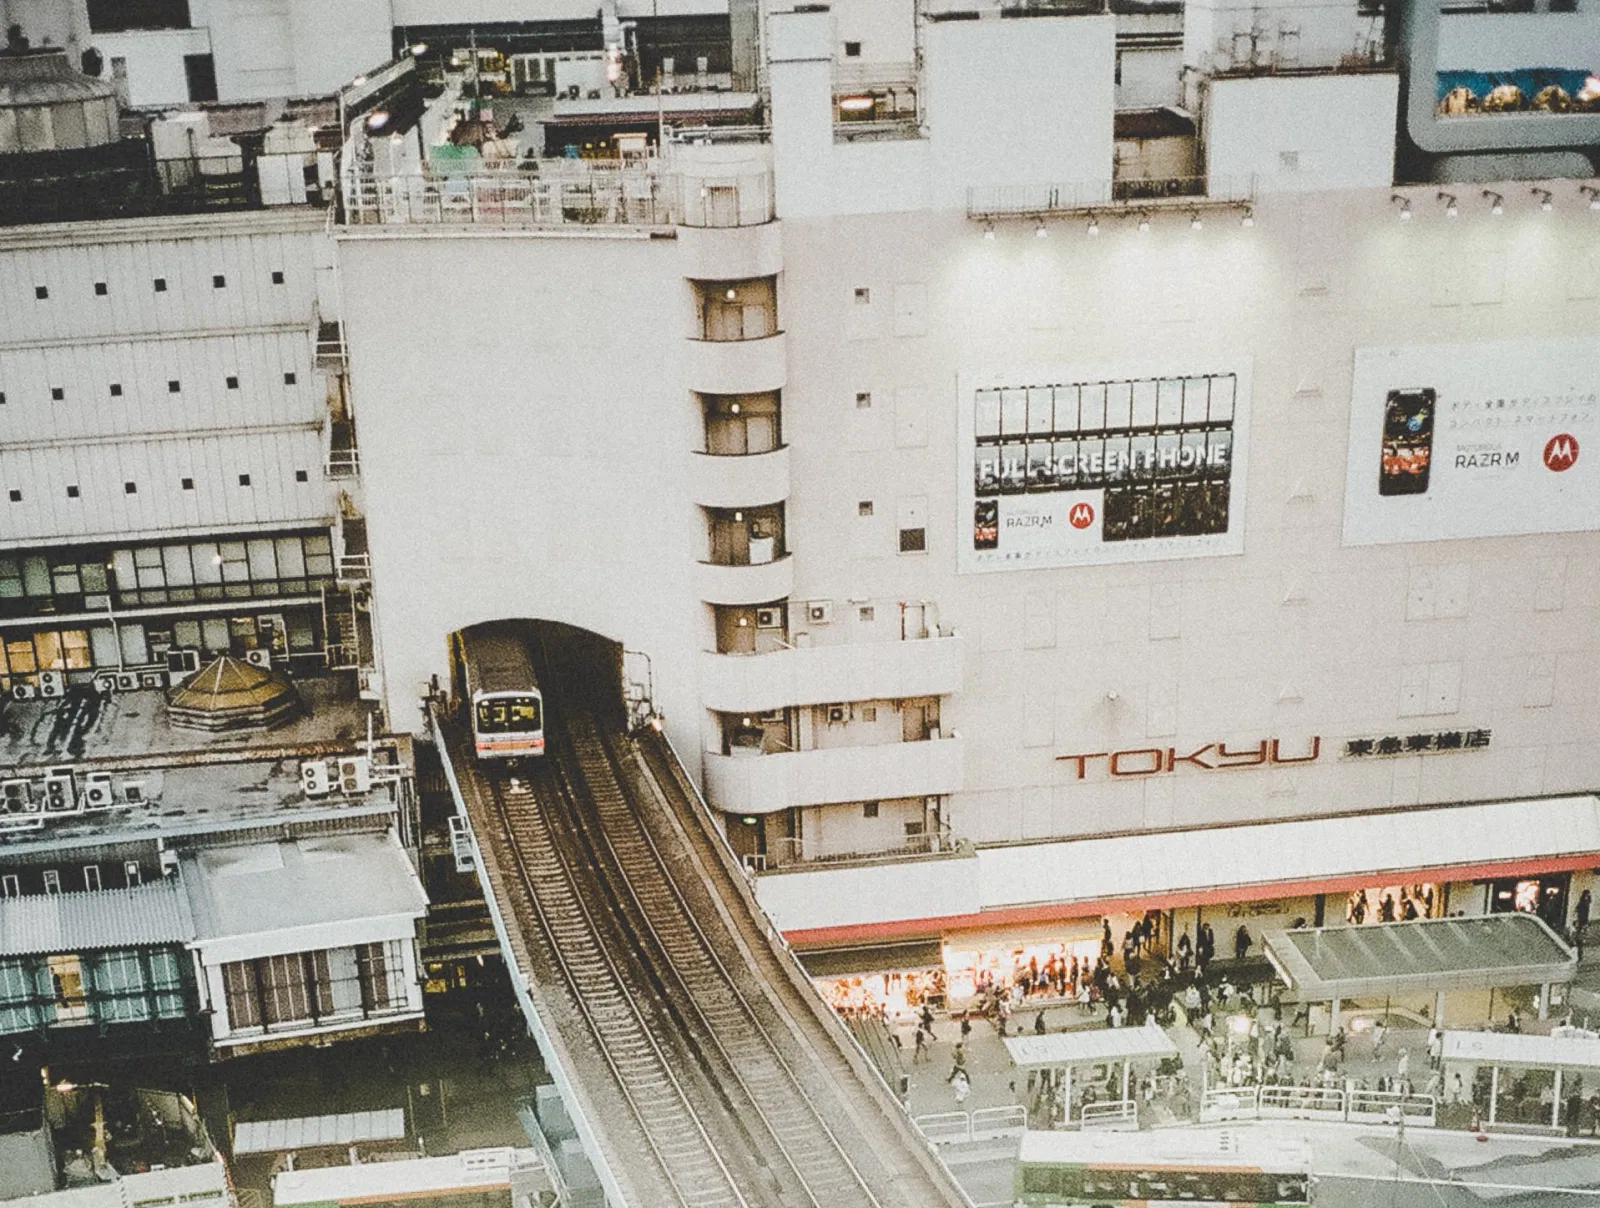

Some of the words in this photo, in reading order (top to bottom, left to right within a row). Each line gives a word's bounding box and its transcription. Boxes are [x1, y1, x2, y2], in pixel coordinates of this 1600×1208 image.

[980, 455, 1040, 481] FULL
[1043, 448, 1136, 475] SCREEN
[1143, 443, 1228, 469] PHONE
[1455, 452, 1502, 469] RAZR
[1505, 451, 1520, 466] M
[1006, 515, 1040, 529] RAZR
[1055, 736, 1320, 779] TOKYU
